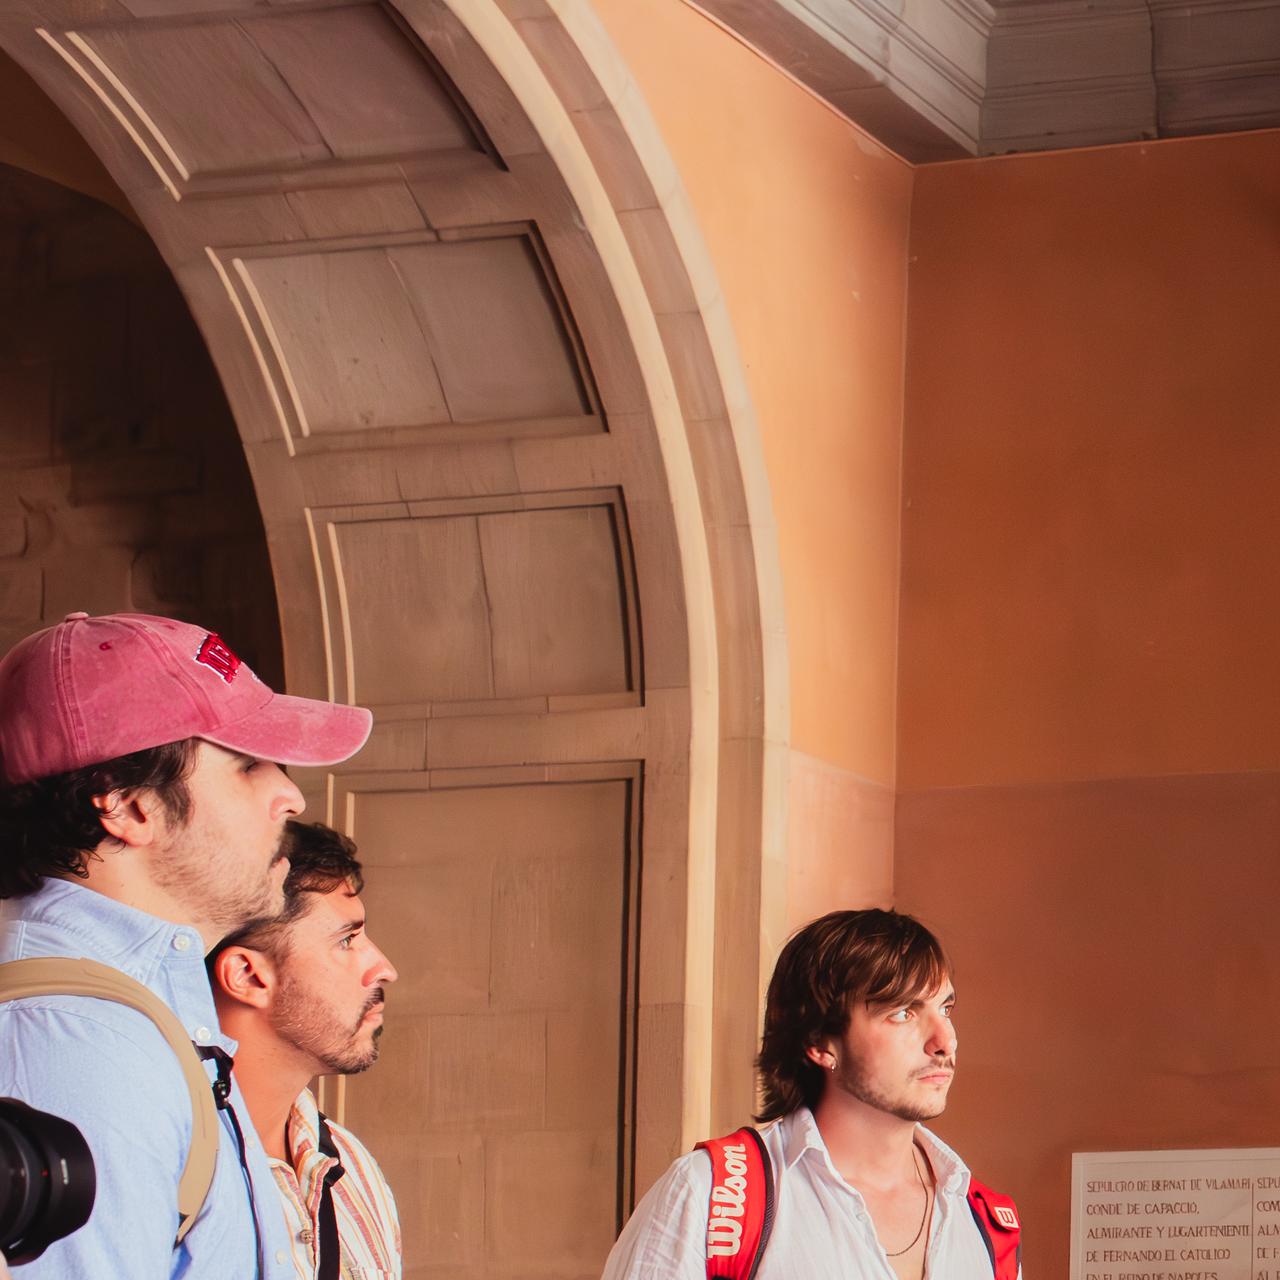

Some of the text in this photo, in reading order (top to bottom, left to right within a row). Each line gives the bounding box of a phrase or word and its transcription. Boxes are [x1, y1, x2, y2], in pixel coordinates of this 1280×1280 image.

[1137, 1180, 1150, 1192] DE
[1190, 1178, 1202, 1191] DE
[706, 1143, 748, 1259] Wilson
[1086, 1203, 1122, 1215] CONDE
[1127, 1203, 1140, 1215] DE
[1087, 1226, 1153, 1239] ALMIRANTE
[1157, 1226, 1164, 1238] Y
[1086, 1250, 1097, 1263] DE
[1104, 1249, 1162, 1262] FERNANDO
[1165, 1249, 1176, 1261] EL
[1257, 1247, 1269, 1258] DE
